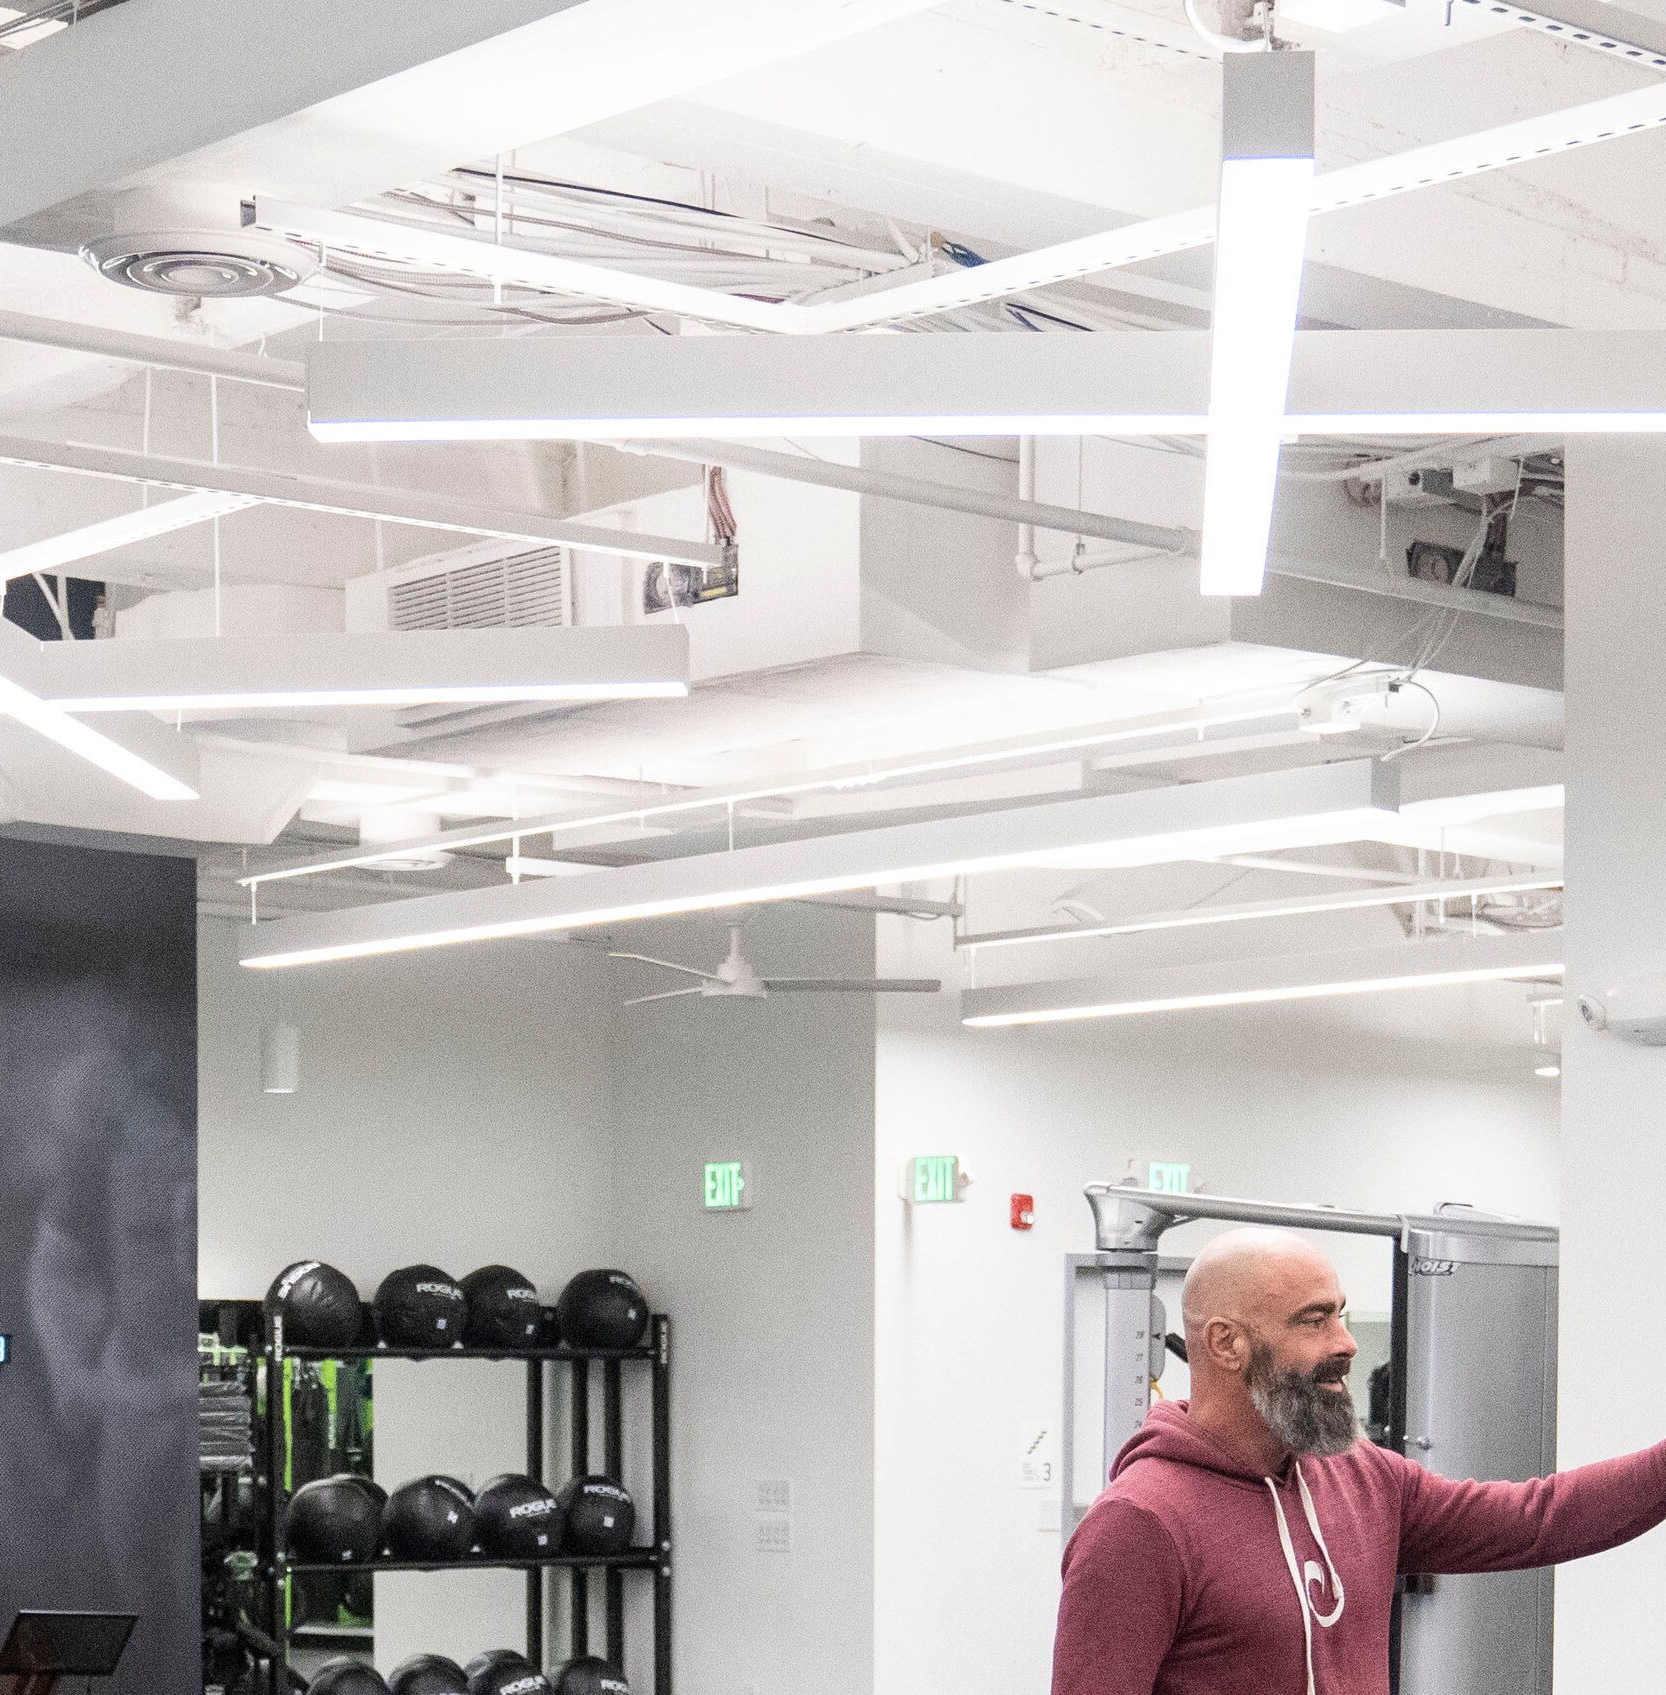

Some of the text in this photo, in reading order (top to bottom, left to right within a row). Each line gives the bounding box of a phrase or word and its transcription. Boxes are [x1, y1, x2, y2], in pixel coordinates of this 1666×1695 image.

[704, 1162, 741, 1207] EXIT
[914, 1156, 955, 1201] EXIT
[1148, 1161, 1191, 1193] EXIT
[1043, 1461, 1051, 1482] 3
